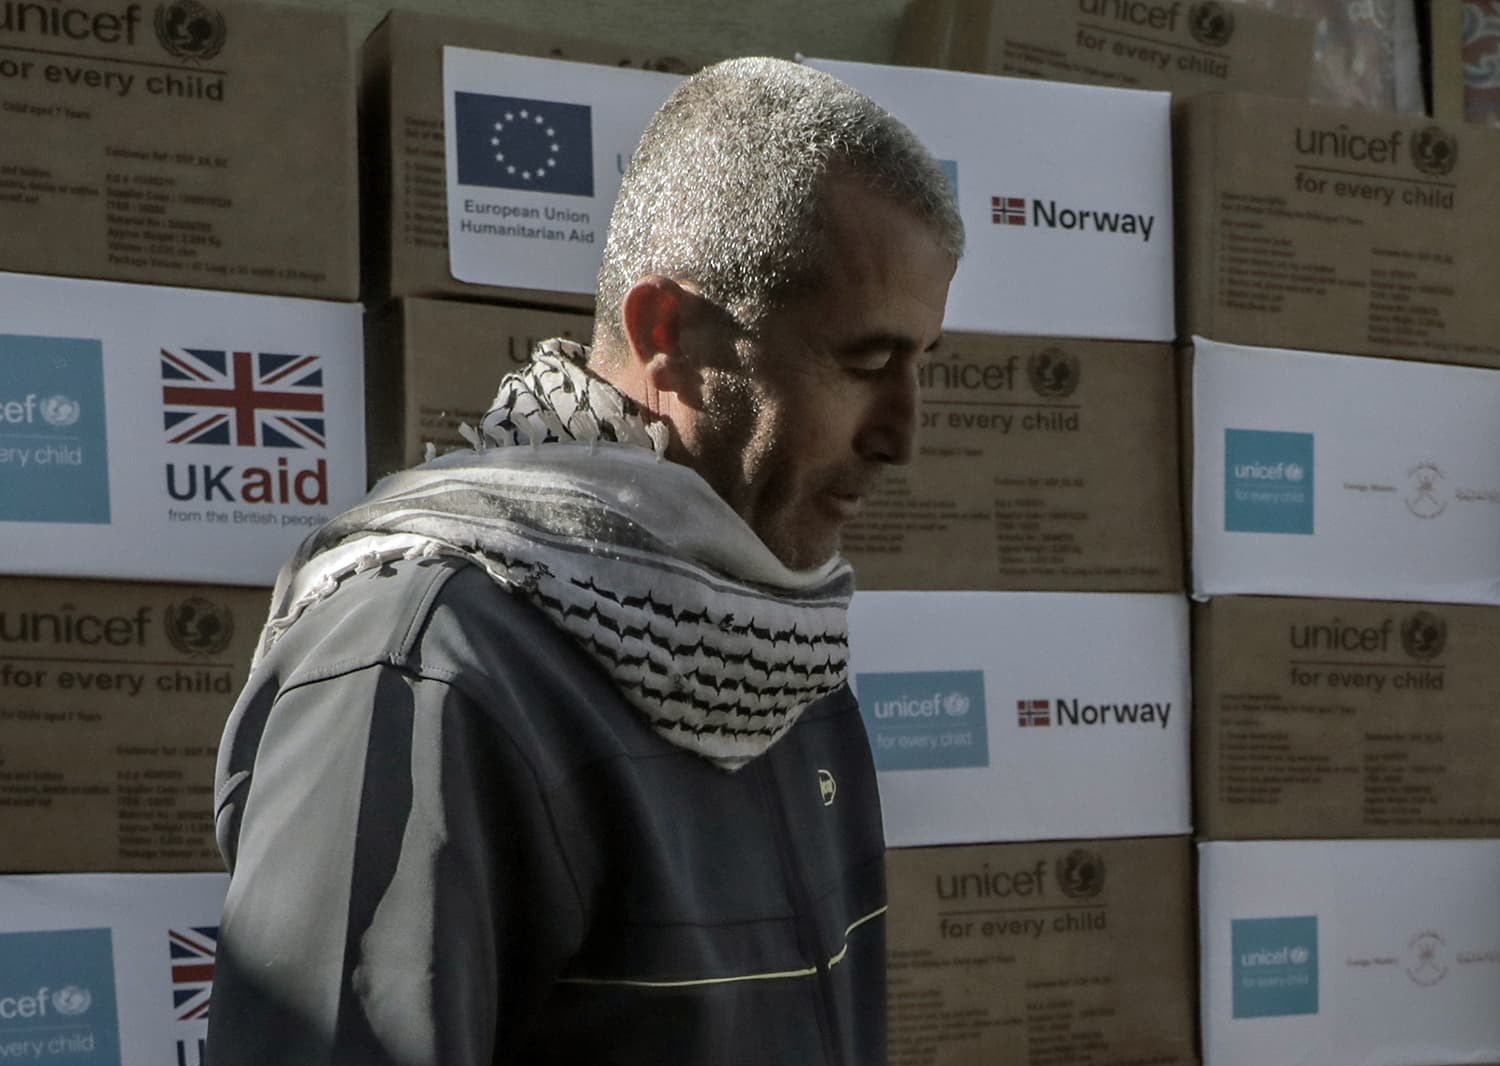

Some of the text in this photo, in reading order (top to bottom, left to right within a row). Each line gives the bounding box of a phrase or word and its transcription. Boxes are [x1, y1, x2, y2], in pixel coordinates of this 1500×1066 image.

[1076, 29, 1107, 50] for
[1112, 38, 1170, 70] every
[1177, 50, 1228, 80] child
[0, 58, 224, 101] or every child
[1295, 124, 1403, 165] unicef
[1295, 171, 1455, 210] for every child
[464, 199, 590, 224] European Union
[1033, 200, 1154, 241] Norway
[460, 219, 594, 244] Humanitarian Aid
[921, 412, 1080, 434] or every child
[0, 444, 82, 466] ery child
[165, 457, 329, 506] UKaid
[1235, 462, 1285, 480] unicef
[168, 509, 202, 523] from
[205, 510, 229, 524] the
[233, 510, 278, 525] British
[0, 602, 152, 647] unicef
[1289, 616, 1392, 651] unicef
[1, 664, 232, 696] for every child
[1289, 668, 1445, 692] for every child
[873, 693, 941, 719] unicef
[1056, 699, 1172, 728] Norway
[936, 860, 1047, 901] unicef
[939, 911, 1107, 939] for every child
[1242, 948, 1288, 966] unicef
[0, 1033, 94, 1058] very child
